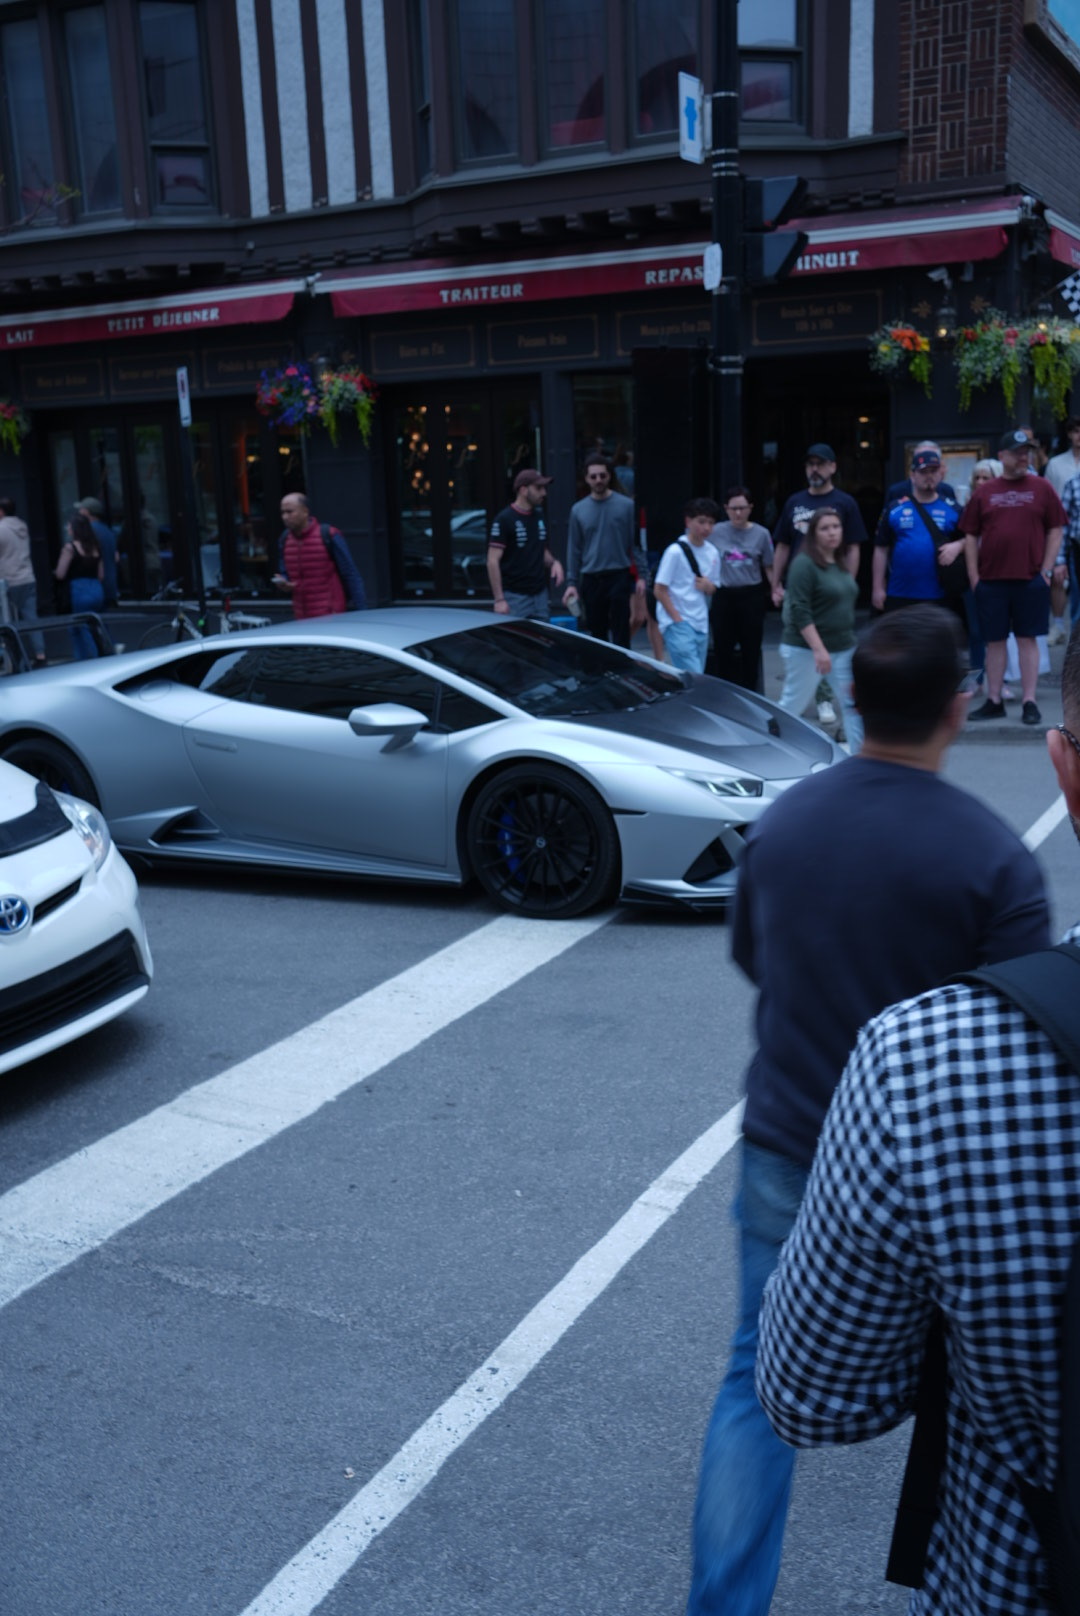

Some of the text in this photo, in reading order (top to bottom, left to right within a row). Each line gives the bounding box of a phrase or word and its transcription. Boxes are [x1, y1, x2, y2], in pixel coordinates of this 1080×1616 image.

[645, 266, 704, 285] REPAS
[439, 282, 524, 304] TRAITEUR
[107, 307, 220, 333] PETIT DÉJEUNER
[6, 329, 35, 345] LAIT
